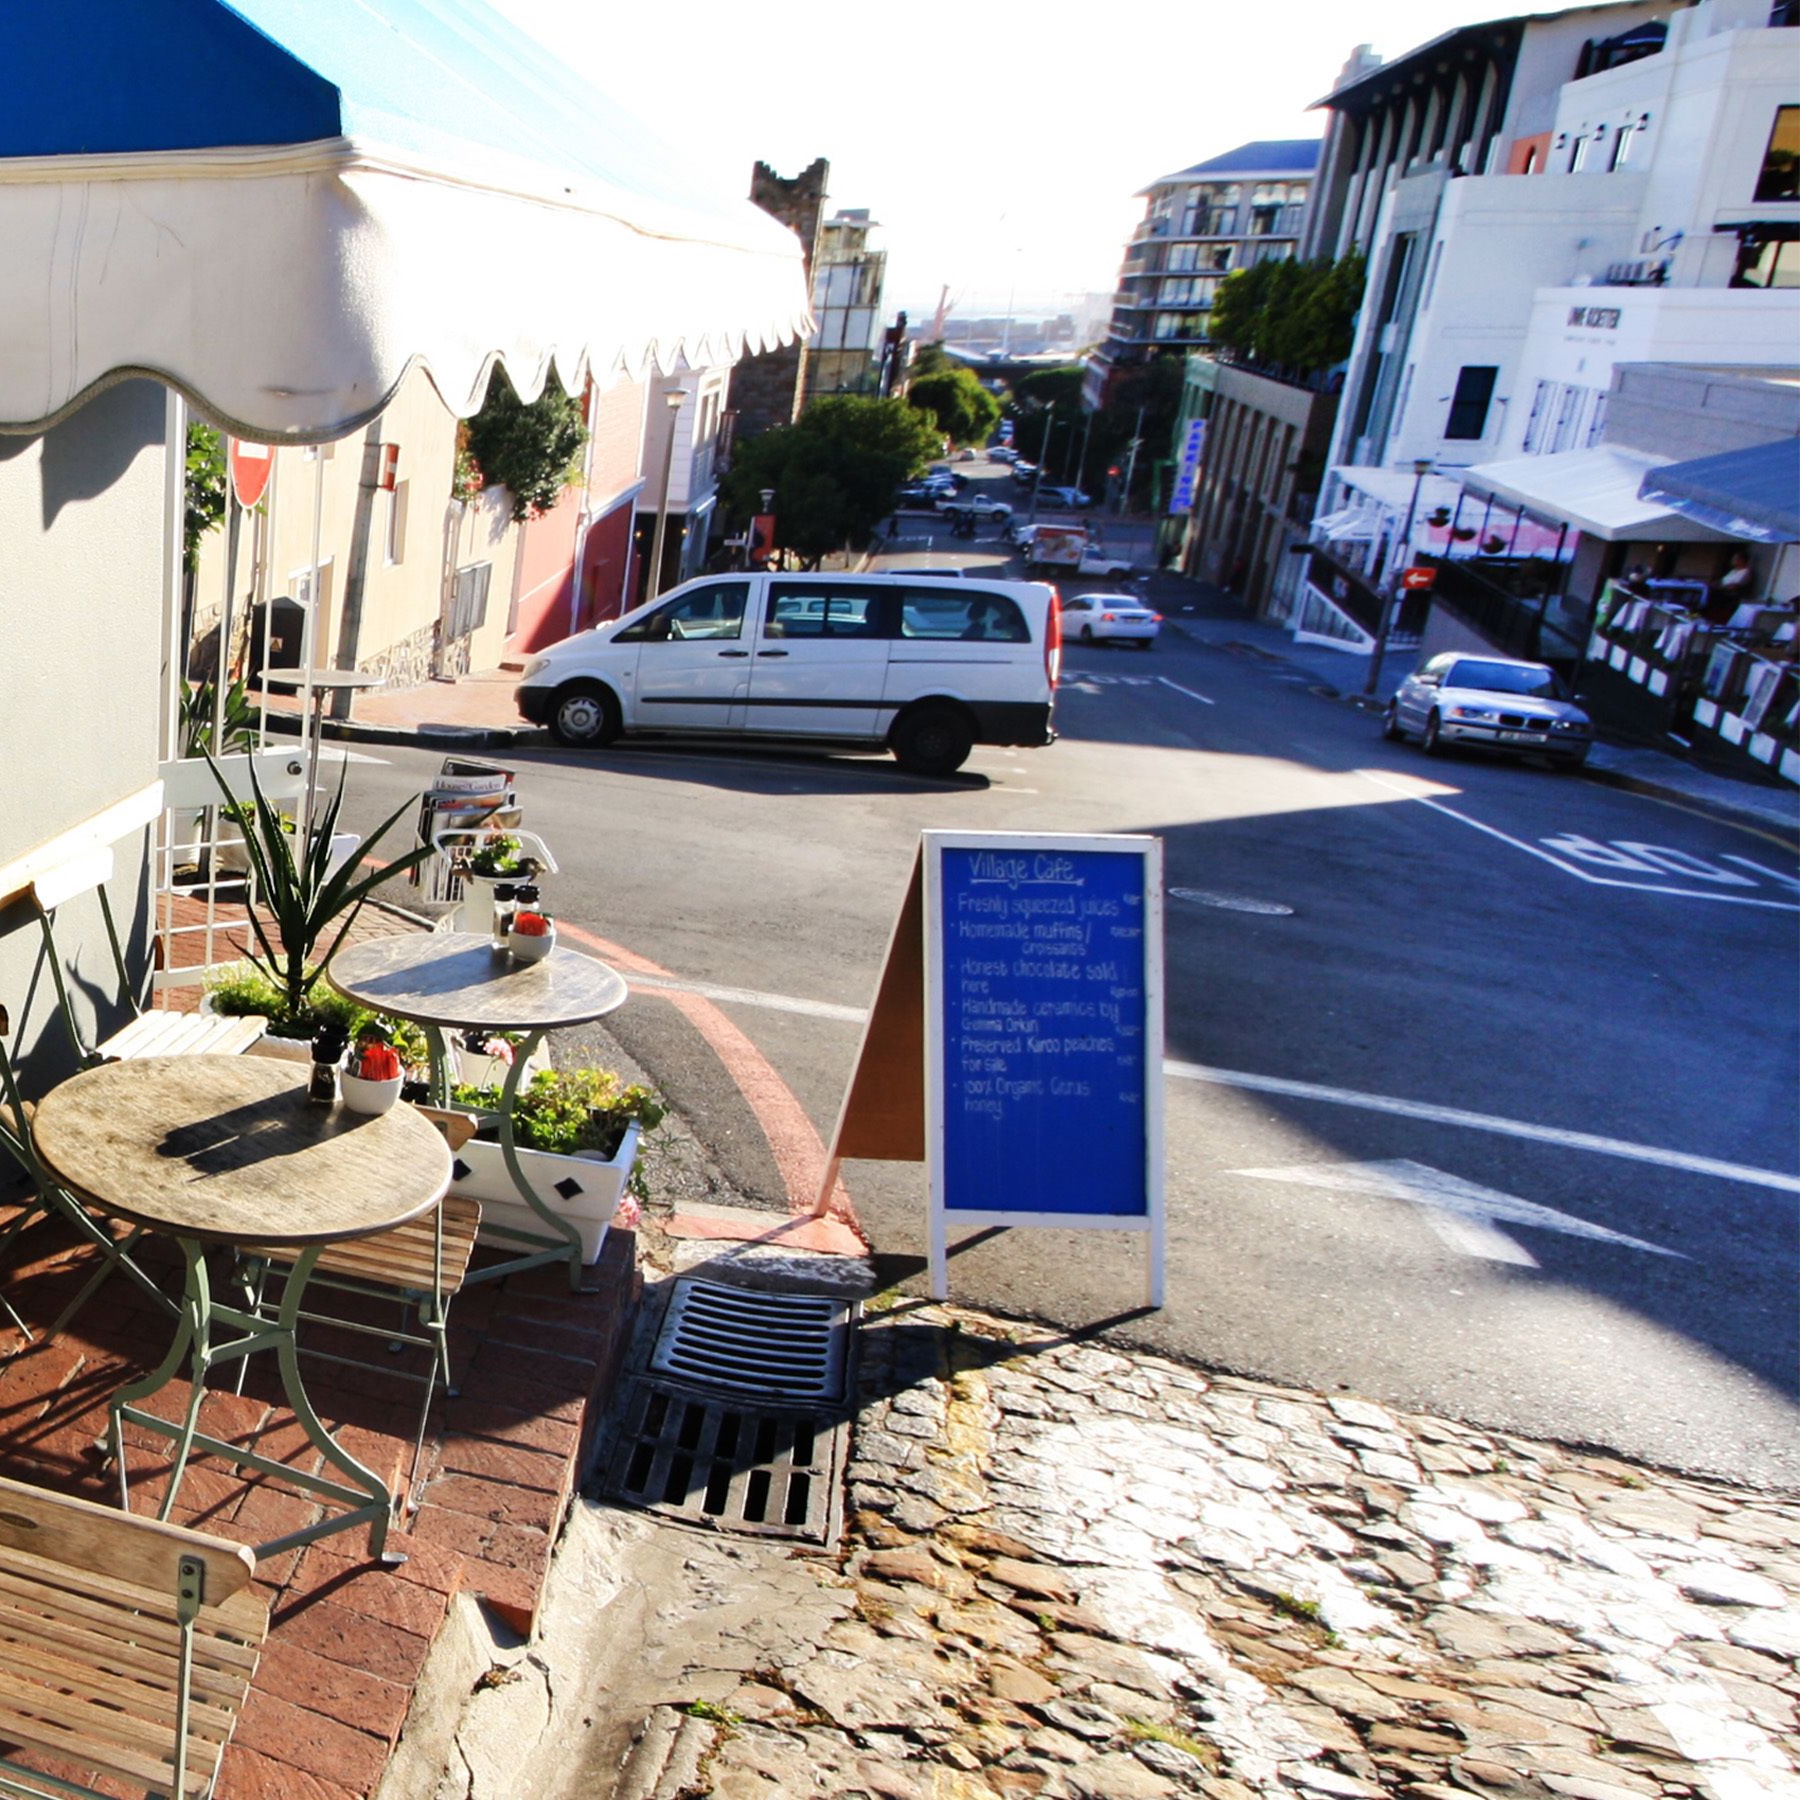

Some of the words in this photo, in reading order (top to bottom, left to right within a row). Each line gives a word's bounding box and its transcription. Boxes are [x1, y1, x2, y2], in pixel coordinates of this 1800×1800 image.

[968, 852, 1029, 890] Village
[957, 892, 1009, 920] Freshly
[1011, 895, 1076, 919] squeezed
[1078, 894, 1120, 921] juices
[959, 920, 1030, 940] Homemade
[961, 957, 1009, 977] Honest
[1085, 961, 1118, 981] sold
[961, 979, 990, 994] here
[961, 998, 1027, 1016] Handmade
[1033, 1001, 1096, 1018] ceramics
[1100, 1001, 1119, 1024] by
[961, 1035, 1022, 1054] Preserved
[1064, 1037, 1114, 1056] peaches
[961, 1058, 981, 1072] for
[995, 1076, 1045, 1101] Organic
[963, 1097, 1003, 1120] honey
